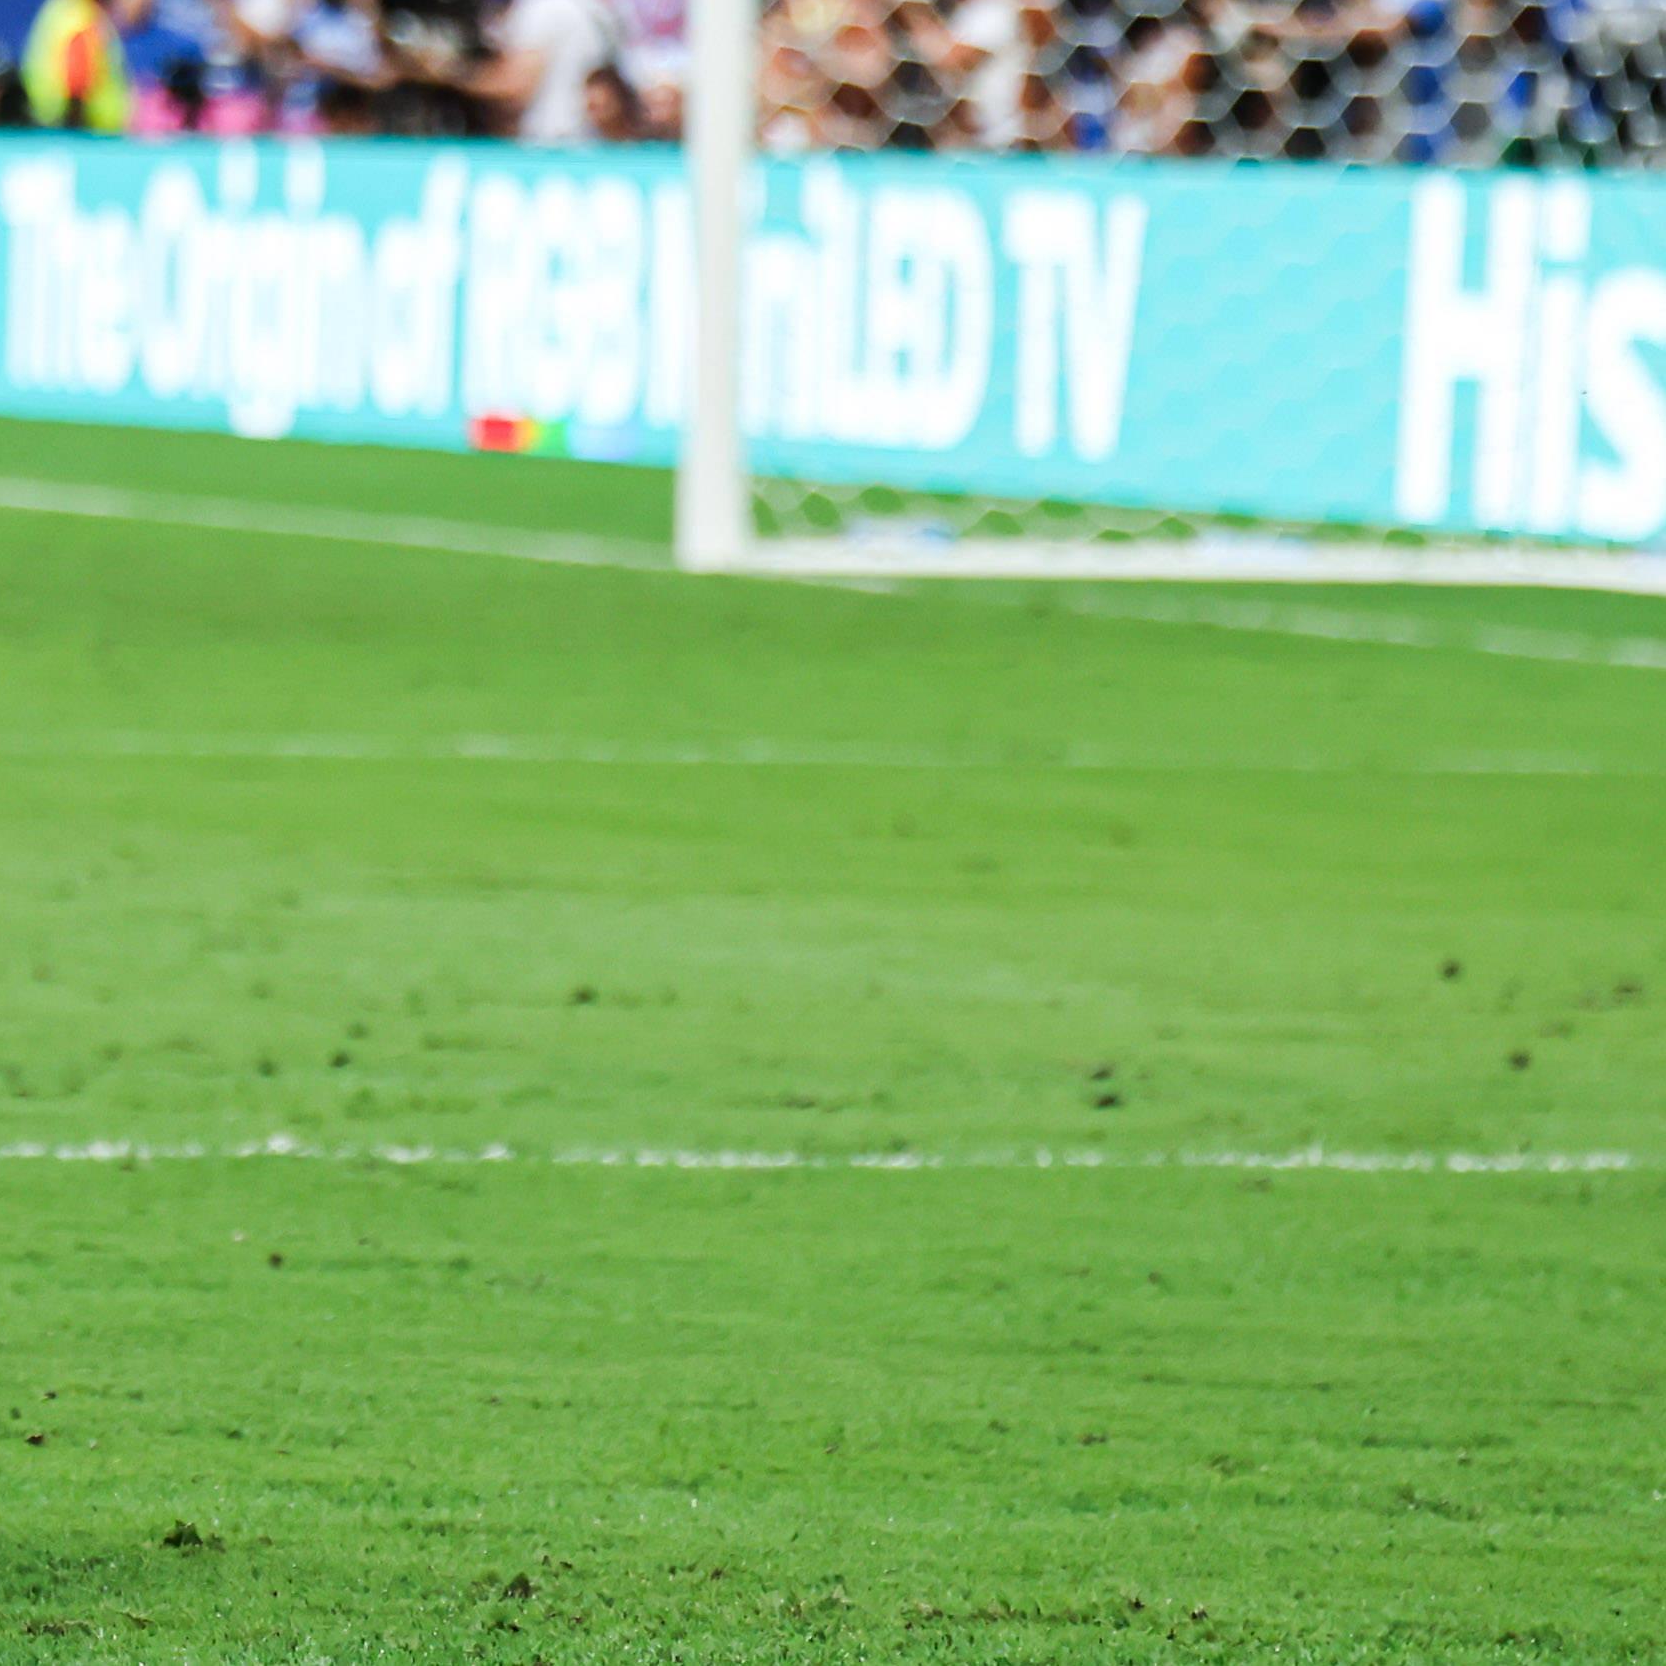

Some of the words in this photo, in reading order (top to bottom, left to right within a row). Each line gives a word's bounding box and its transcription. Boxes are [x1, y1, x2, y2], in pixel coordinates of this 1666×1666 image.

[0, 150, 135, 394] The
[137, 134, 367, 440] Origin
[1001, 186, 1151, 462] TV
